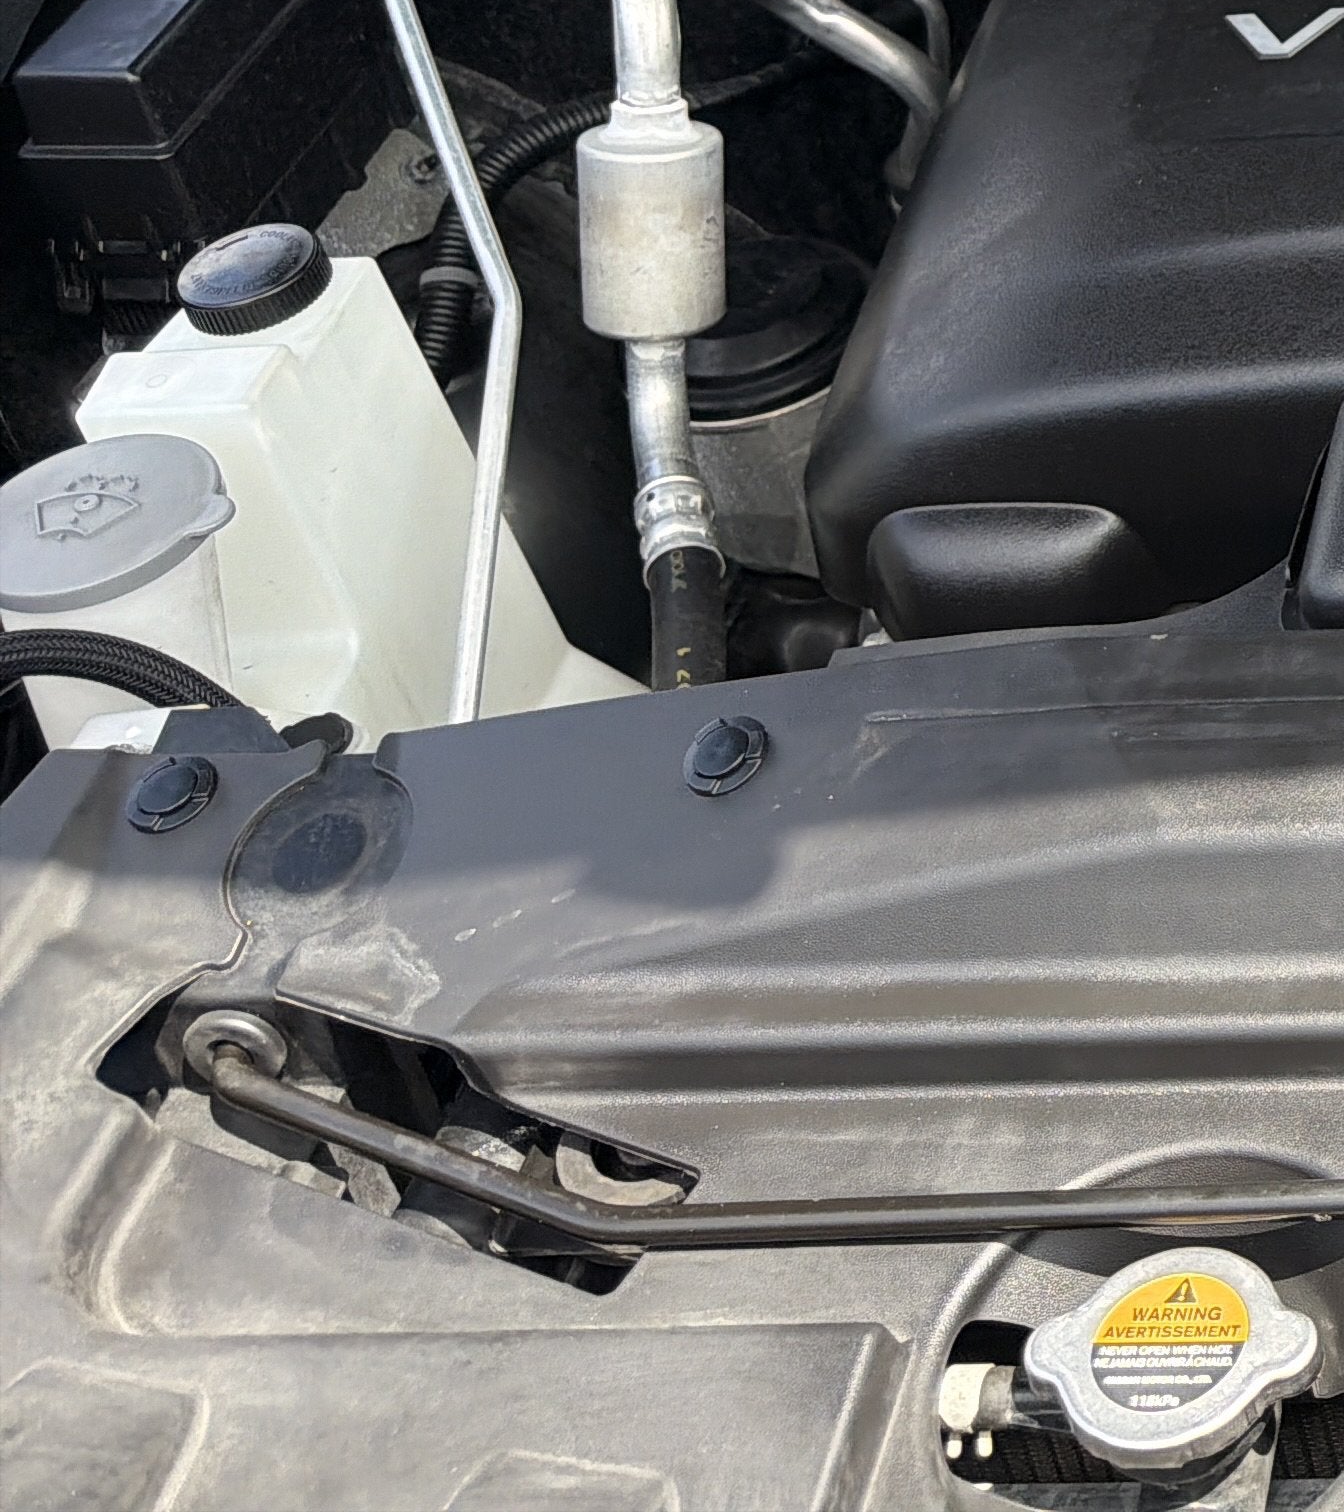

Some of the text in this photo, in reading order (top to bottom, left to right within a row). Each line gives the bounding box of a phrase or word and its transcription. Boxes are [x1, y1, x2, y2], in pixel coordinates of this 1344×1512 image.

[1132, 1307, 1222, 1321] WARNING
[1104, 1325, 1241, 1338] AVERTISSEMENT
[1098, 1346, 1137, 1355] NEVER
[1139, 1346, 1170, 1355] OPEN
[1173, 1345, 1207, 1354] WHEN
